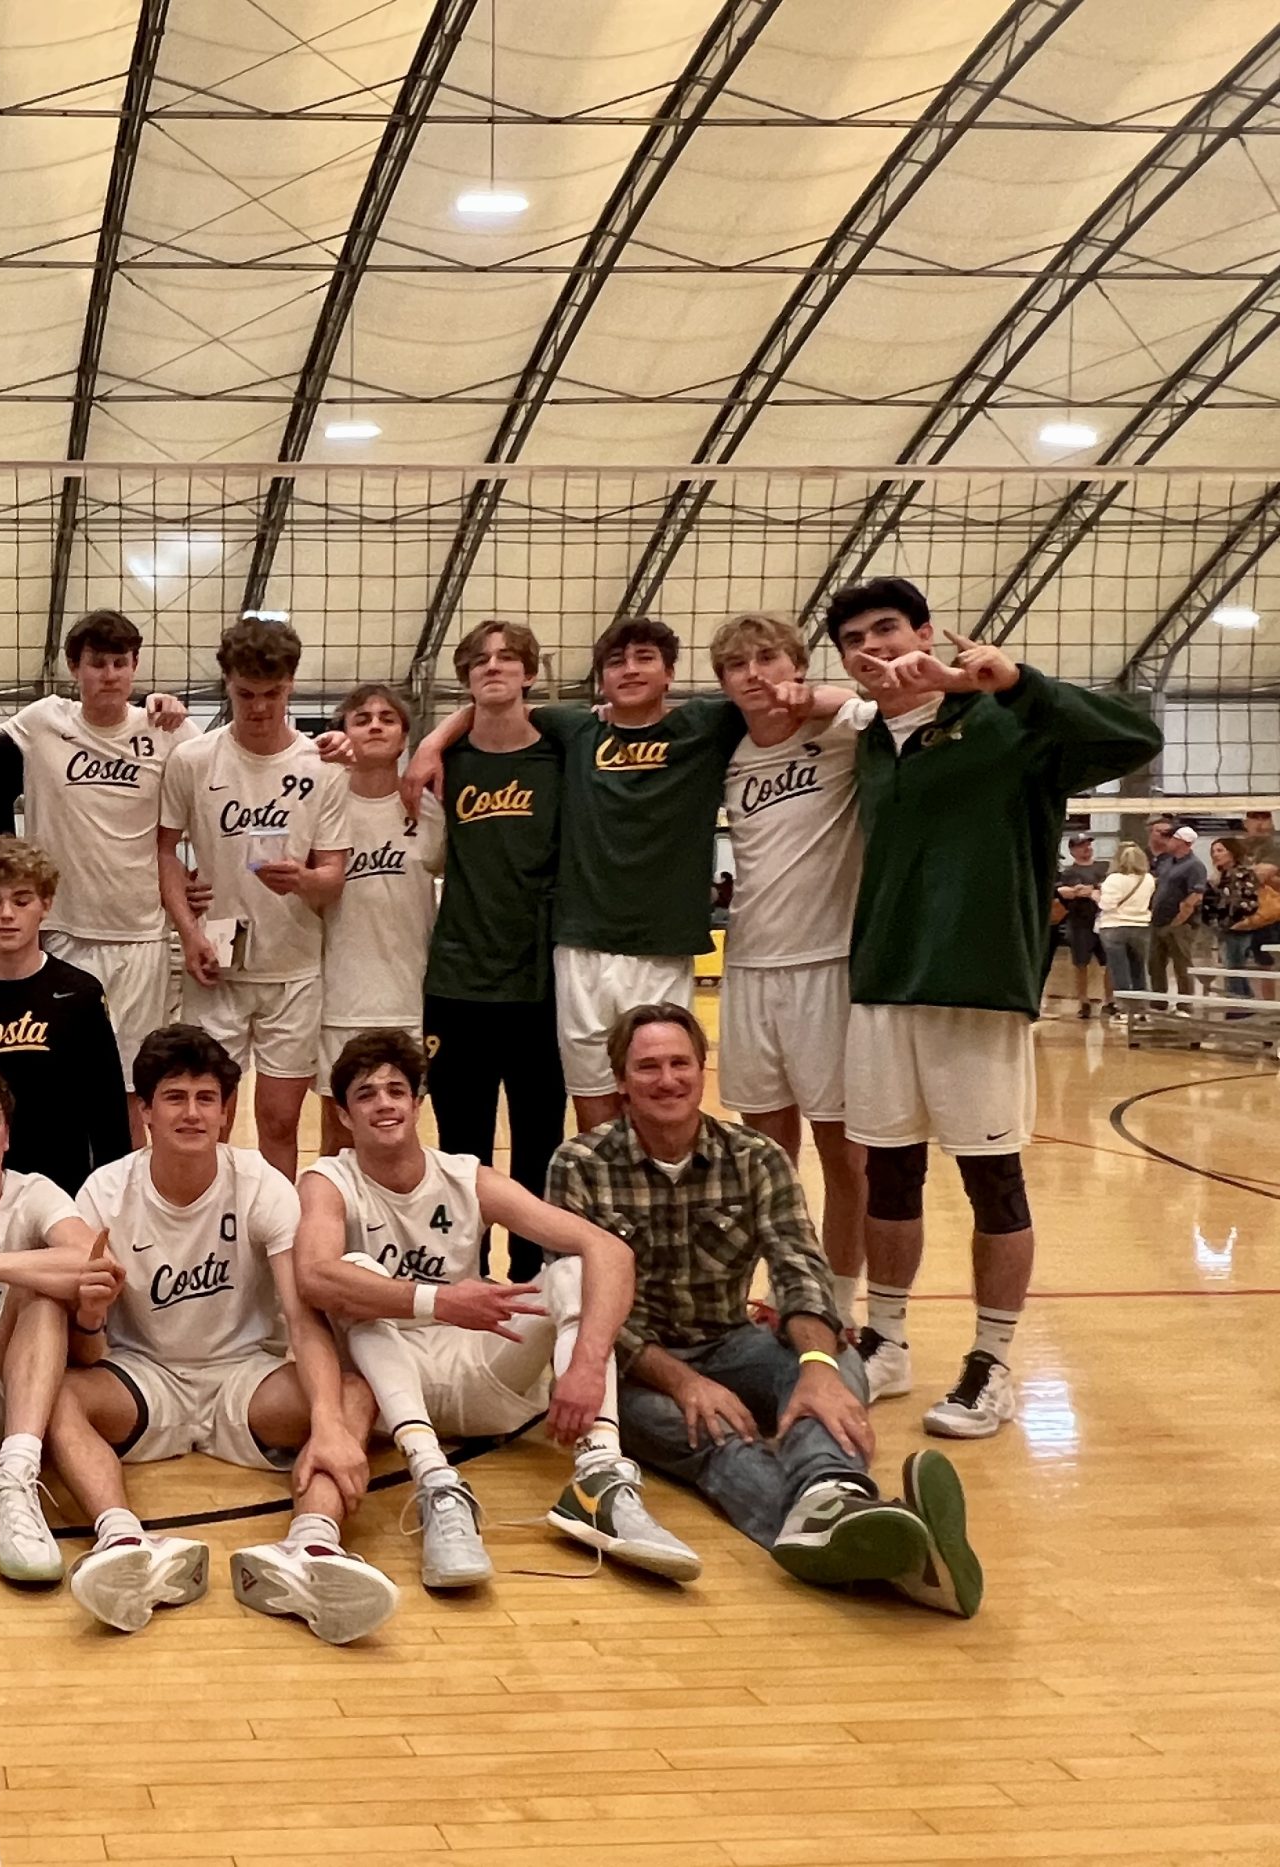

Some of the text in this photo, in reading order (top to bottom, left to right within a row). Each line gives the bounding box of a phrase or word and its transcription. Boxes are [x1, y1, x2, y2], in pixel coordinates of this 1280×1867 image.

[129, 736, 154, 757] 13
[595, 735, 670, 769] Costa
[66, 751, 140, 785] Costa
[281, 775, 315, 800] 99
[456, 780, 533, 822] Costa
[741, 760, 820, 814] Costa
[221, 799, 291, 833] Costa
[403, 816, 418, 837] 2
[219, 1213, 238, 1242] 0
[429, 1204, 453, 1234] 4
[150, 1251, 231, 1306] Costa
